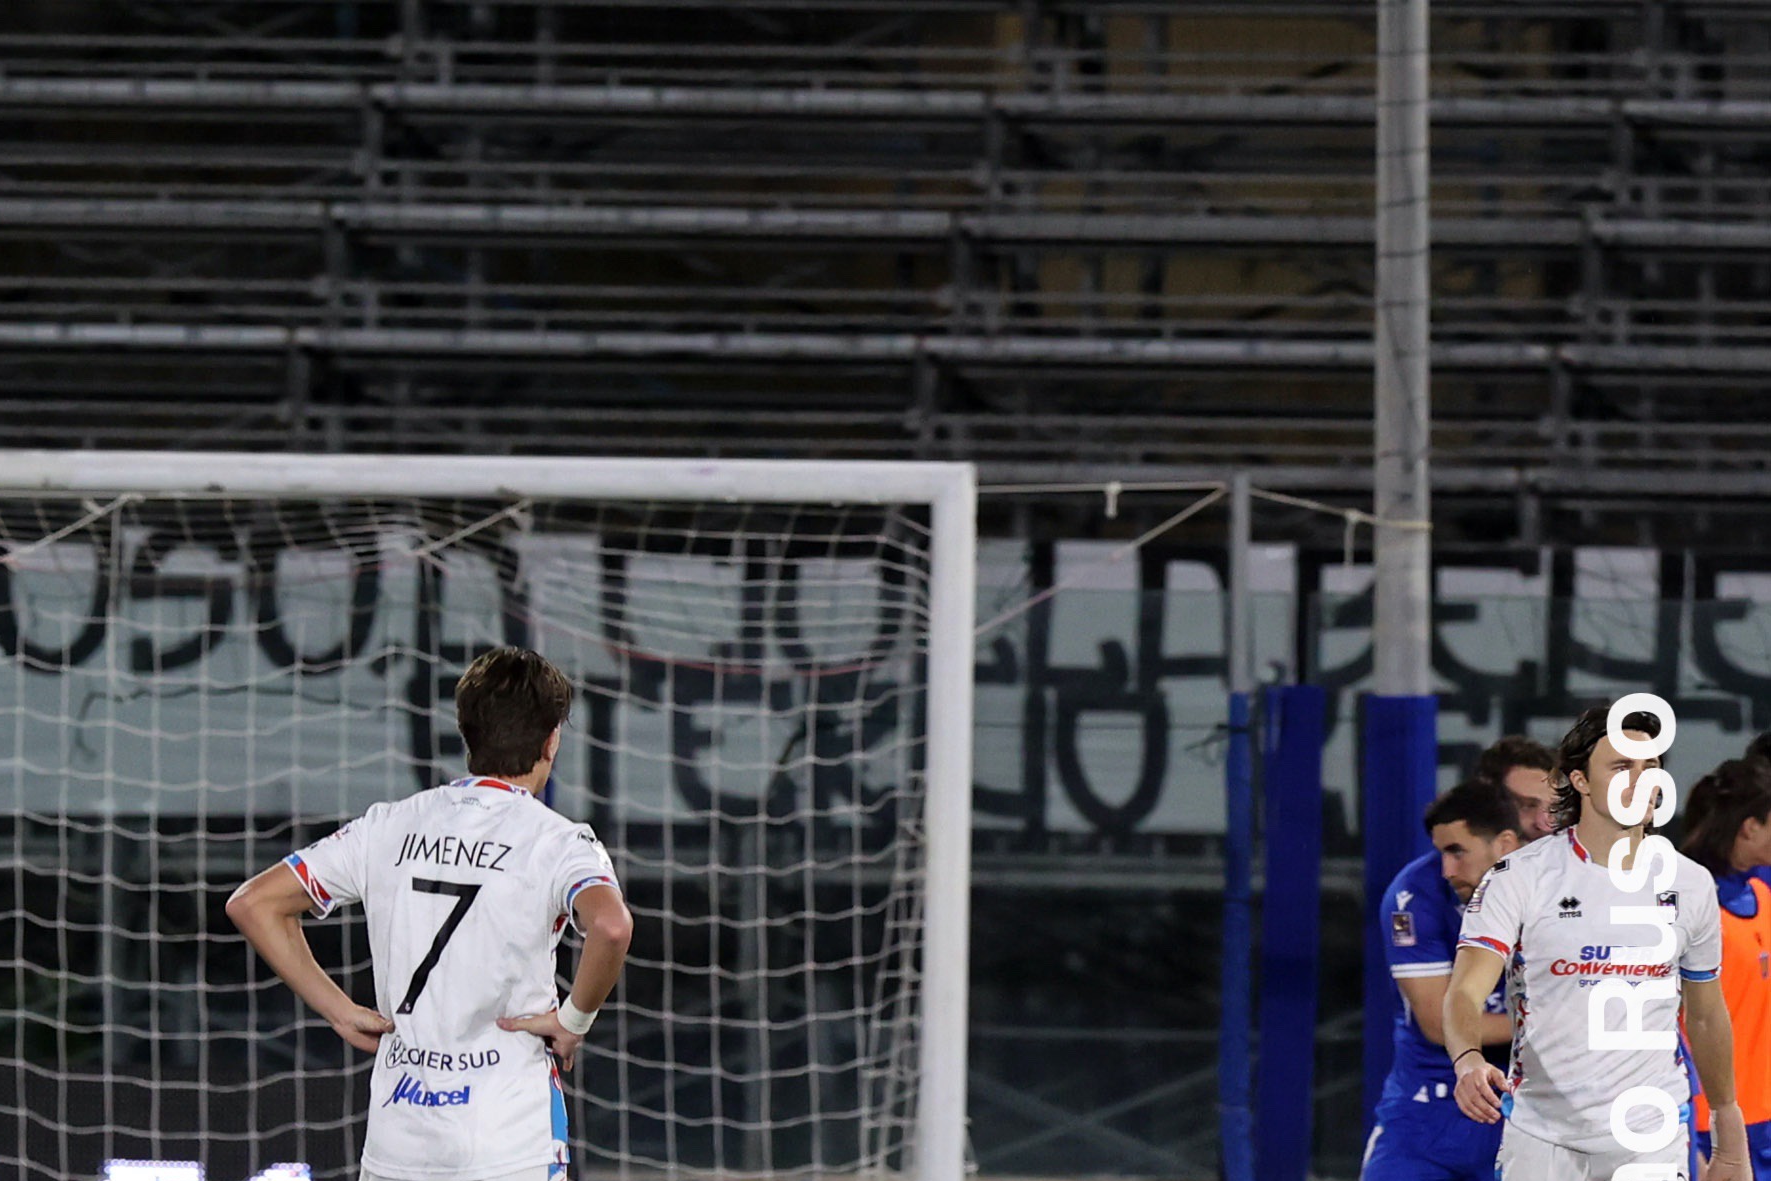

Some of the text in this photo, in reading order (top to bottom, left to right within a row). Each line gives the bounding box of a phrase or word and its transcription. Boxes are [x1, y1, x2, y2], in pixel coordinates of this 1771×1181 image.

[395, 833, 513, 872] JIMENEZ
[396, 876, 483, 1015] 7
[458, 1049, 501, 1071] SUD
